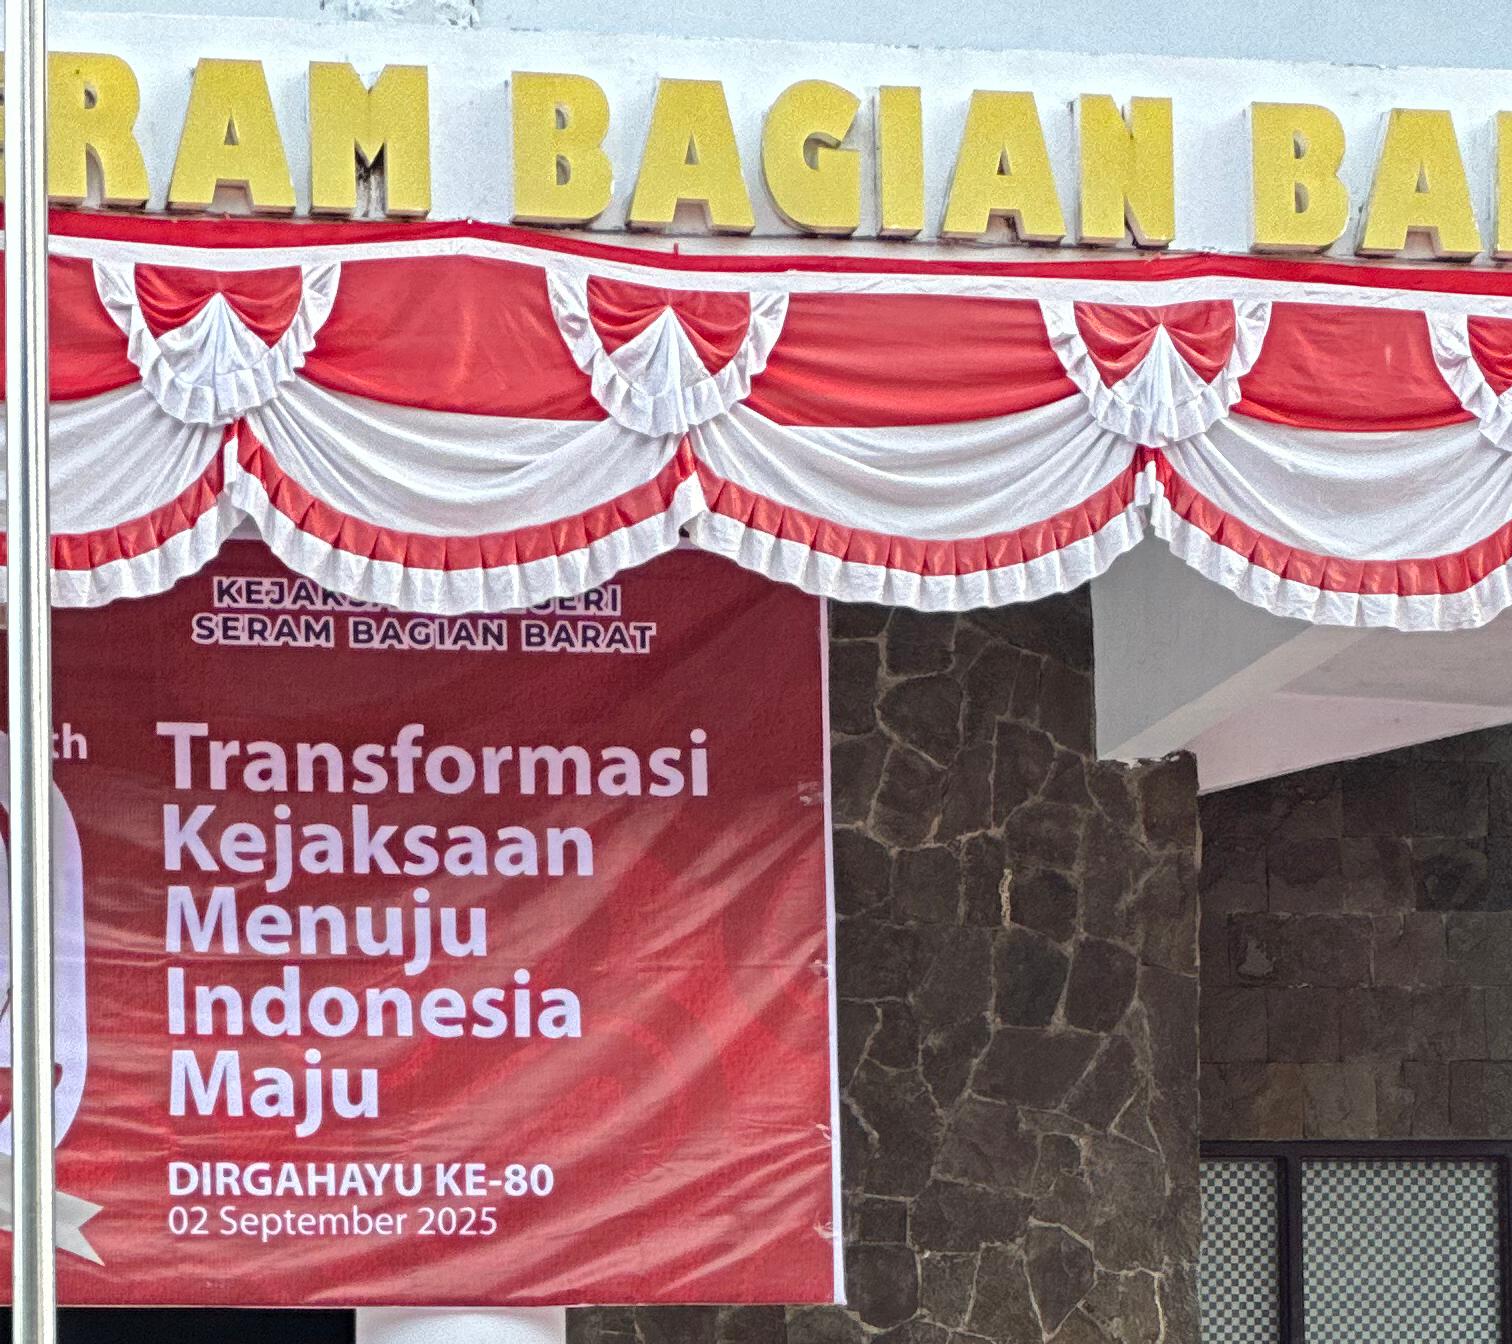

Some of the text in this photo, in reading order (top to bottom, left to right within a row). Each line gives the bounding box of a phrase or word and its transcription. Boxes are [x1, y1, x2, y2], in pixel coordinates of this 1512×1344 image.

[0, 50, 430, 218] RAM
[511, 70, 1175, 248] BAGIAN
[192, 614, 657, 654] SERAM BAGIAN BARAT
[155, 721, 710, 798] Transformasi
[162, 803, 595, 893] Kejaksaan
[164, 885, 488, 976] Menuju
[166, 965, 583, 1039] Indonesia
[168, 1048, 380, 1137] Maju
[167, 1161, 555, 1198] DIRGAHAYU KE-80
[167, 1204, 498, 1243] 02 September 2025
